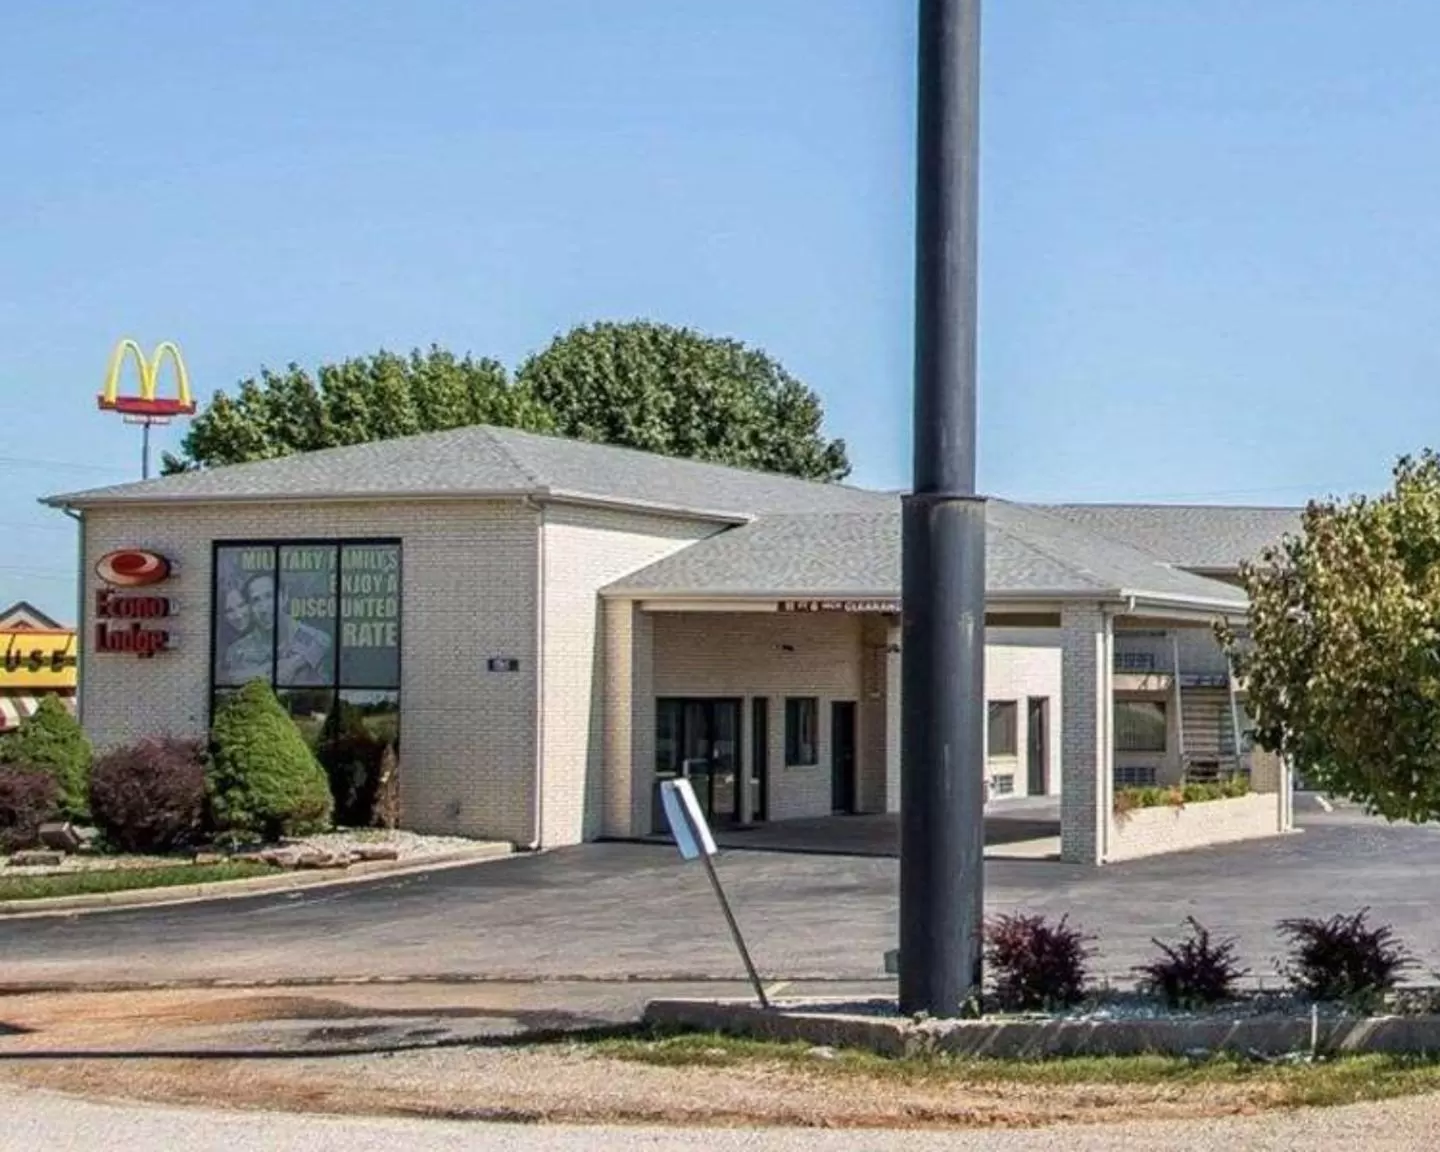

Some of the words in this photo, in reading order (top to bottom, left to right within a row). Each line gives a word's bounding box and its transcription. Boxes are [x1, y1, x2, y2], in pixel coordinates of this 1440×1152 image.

[328, 573, 383, 593] ENJOY
[291, 598, 397, 617] DISCOUNTED
[342, 621, 398, 647] RATE
[5, 649, 66, 673] USE
